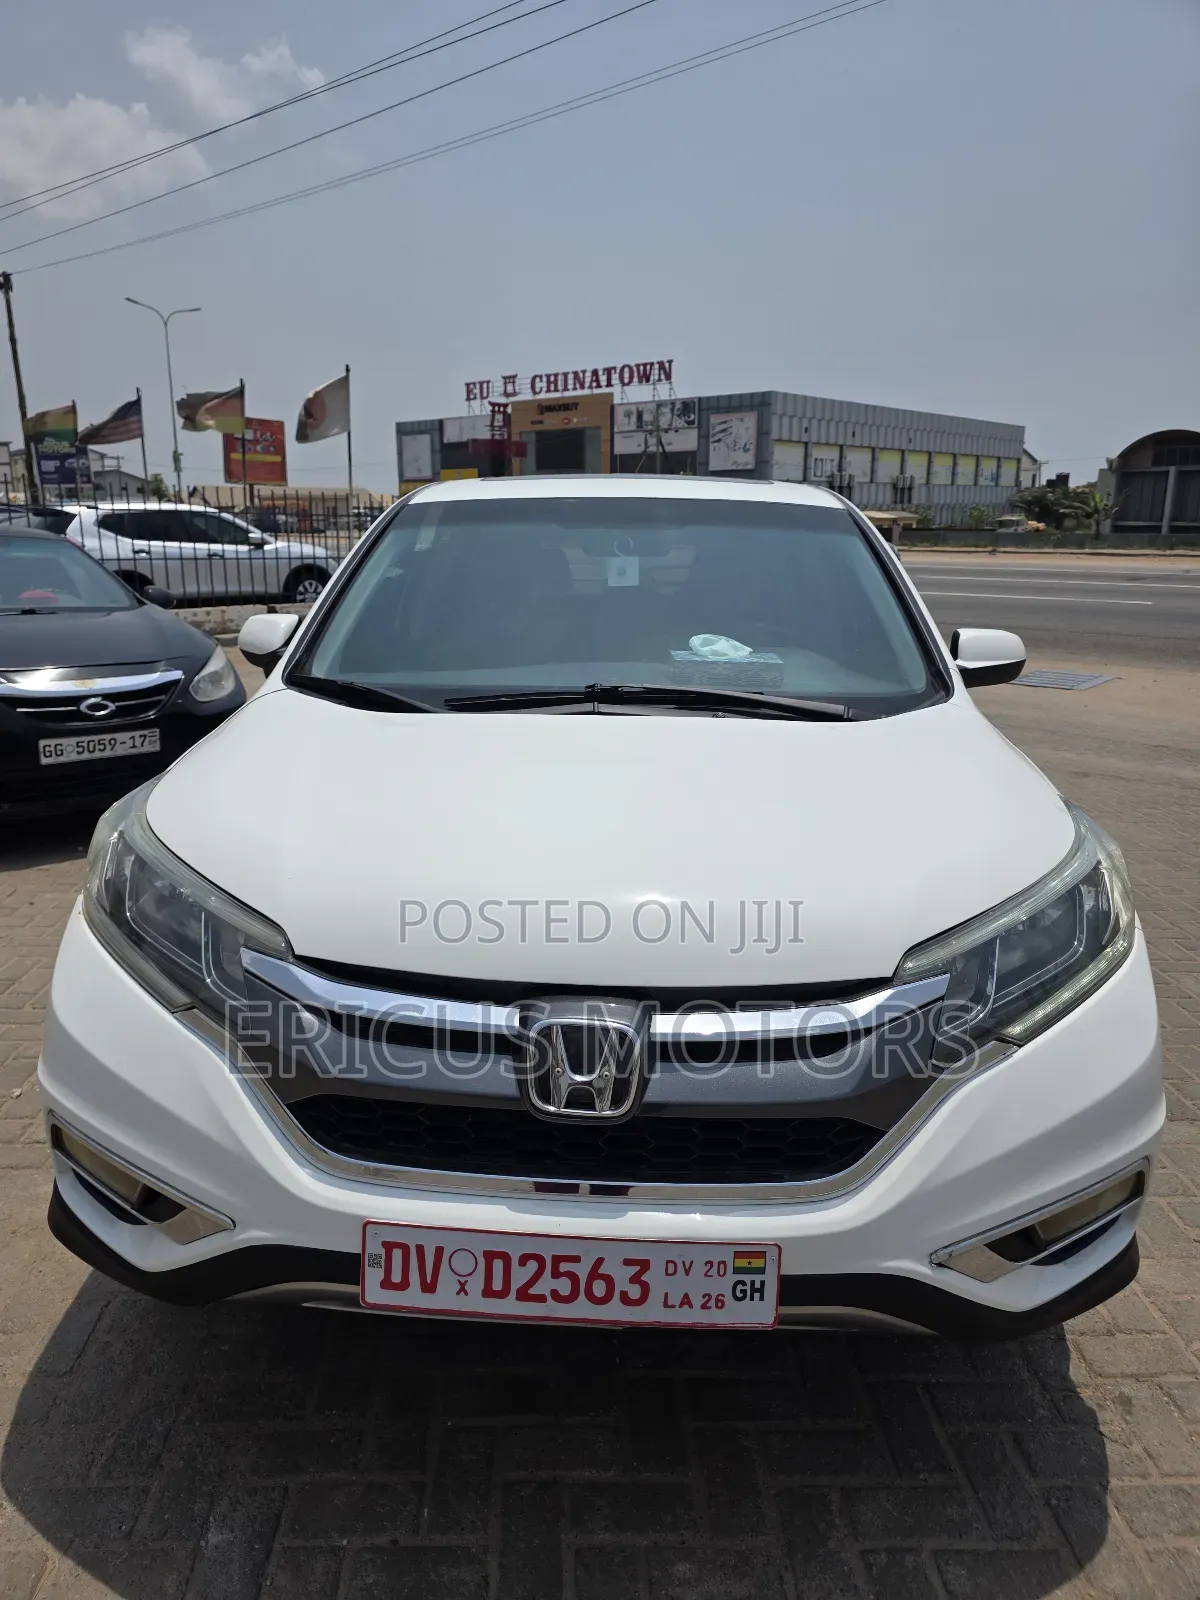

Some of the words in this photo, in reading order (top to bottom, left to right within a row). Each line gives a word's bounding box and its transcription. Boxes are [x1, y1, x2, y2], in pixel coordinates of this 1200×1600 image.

[464, 379, 491, 402] EU
[530, 359, 674, 396] CHINATOWN
[42, 743, 64, 758] GG
[75, 734, 148, 756] 5059-17
[380, 1240, 445, 1295] DV
[481, 1249, 652, 1307] D2563
[665, 1260, 694, 1277] DV
[703, 1260, 728, 1278] 20
[662, 1291, 694, 1310] LA
[700, 1292, 726, 1310] 26
[731, 1279, 766, 1303] GH
